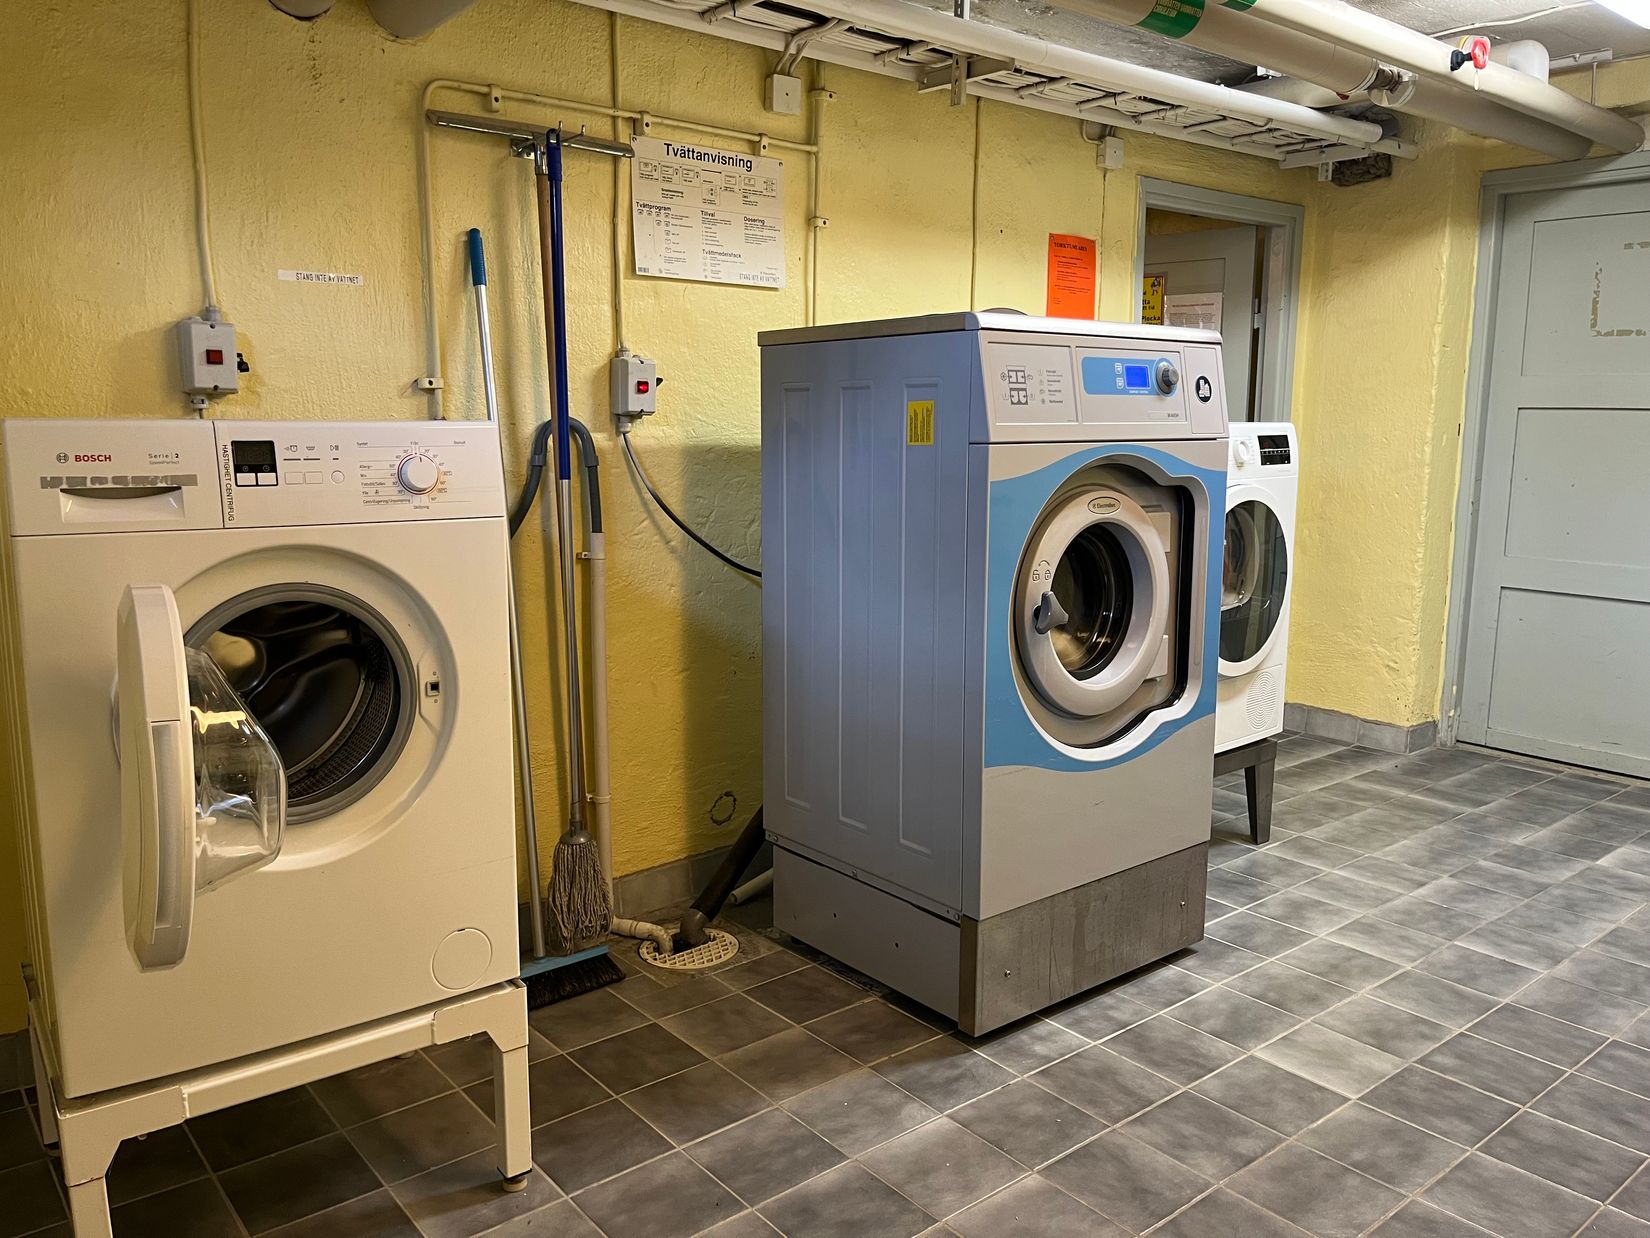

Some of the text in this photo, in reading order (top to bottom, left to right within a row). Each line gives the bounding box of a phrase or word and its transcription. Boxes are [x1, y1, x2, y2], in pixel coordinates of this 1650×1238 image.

[663, 142, 753, 172] Tvättanvisning
[635, 201, 672, 212] Tvättprogram
[700, 209, 716, 219] Tillval
[743, 215, 766, 226] Dosering
[74, 454, 112, 463] BOSCH
[221, 444, 235, 522] HASTIGHET CENTRIFUG
